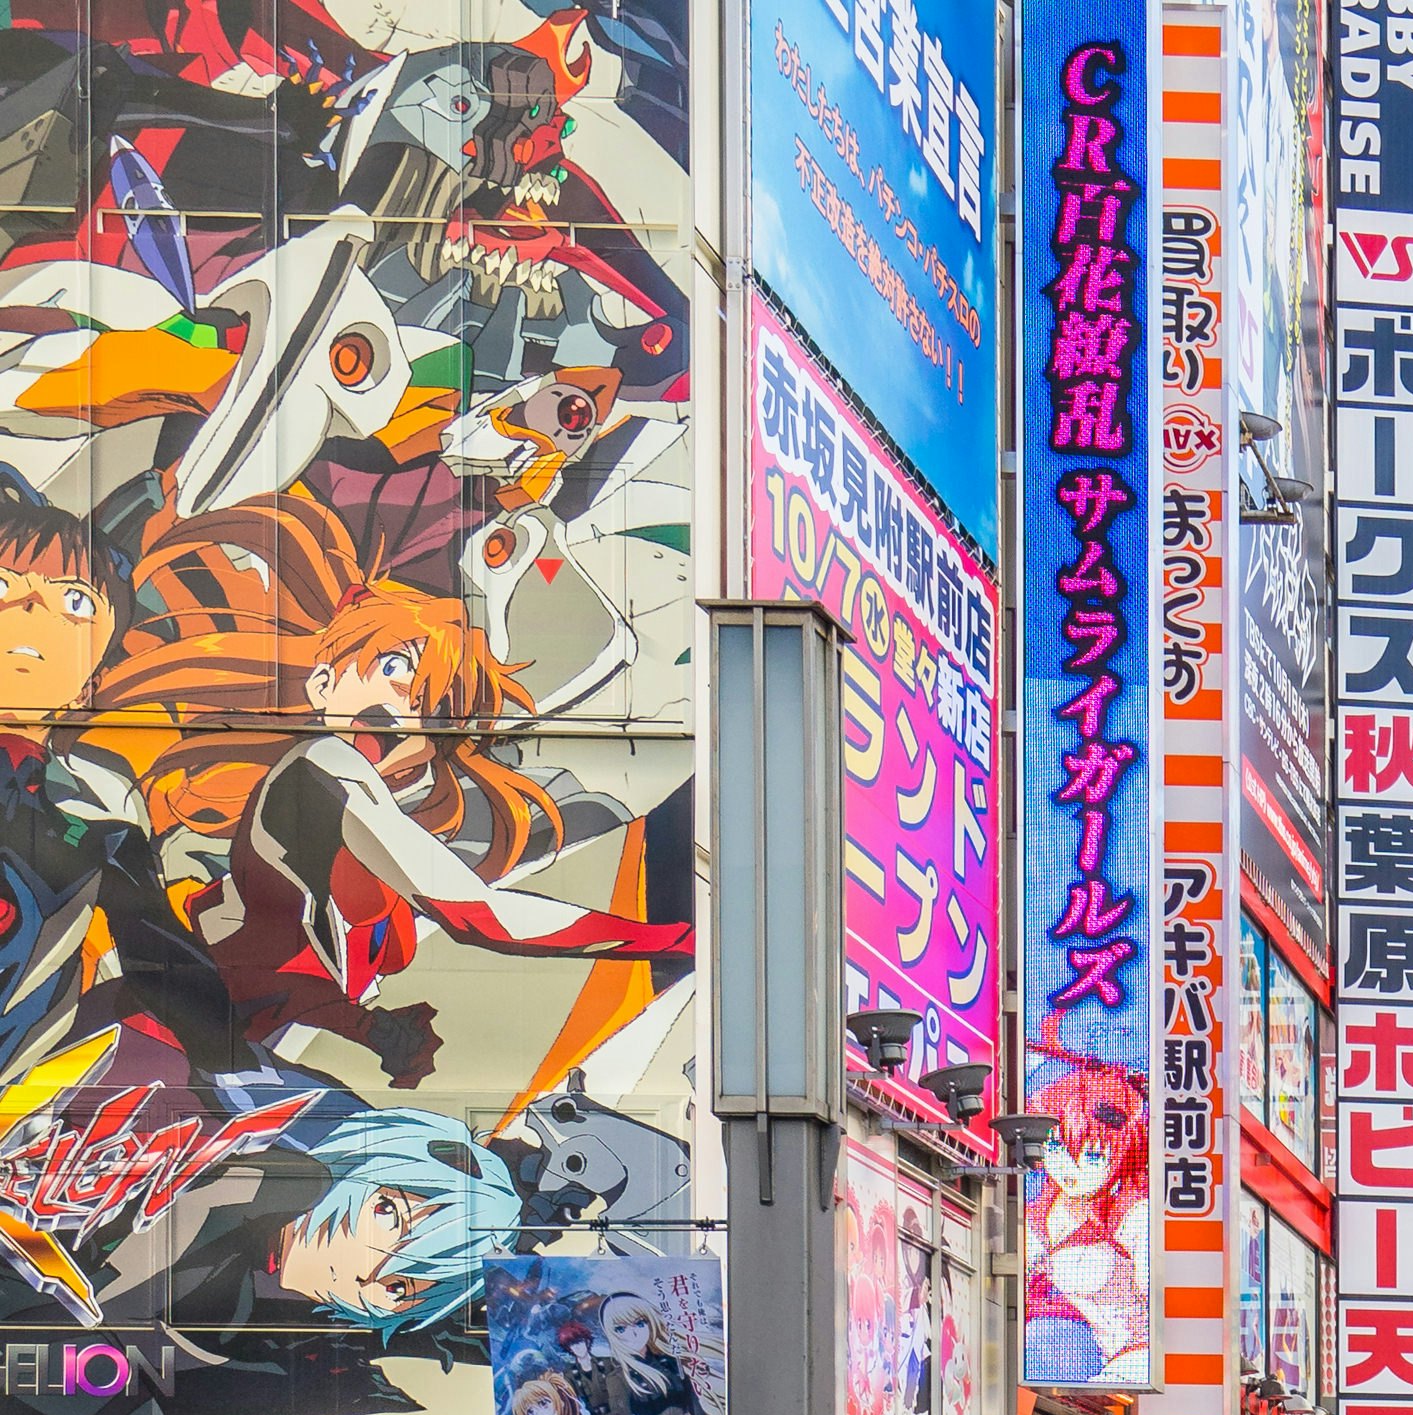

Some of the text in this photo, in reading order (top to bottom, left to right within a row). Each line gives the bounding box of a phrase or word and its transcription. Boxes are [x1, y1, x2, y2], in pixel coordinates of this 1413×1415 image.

[1340, 0, 1380, 195] ADISE
[760, 350, 991, 686] 赤坂見附駅前店
[1053, 472, 1134, 1005] サムライガールズ
[1163, 865, 1208, 1211] アキバ駅前店
[0, 1343, 176, 1397] ELION
[670, 1274, 713, 1398] 君を守りたい
